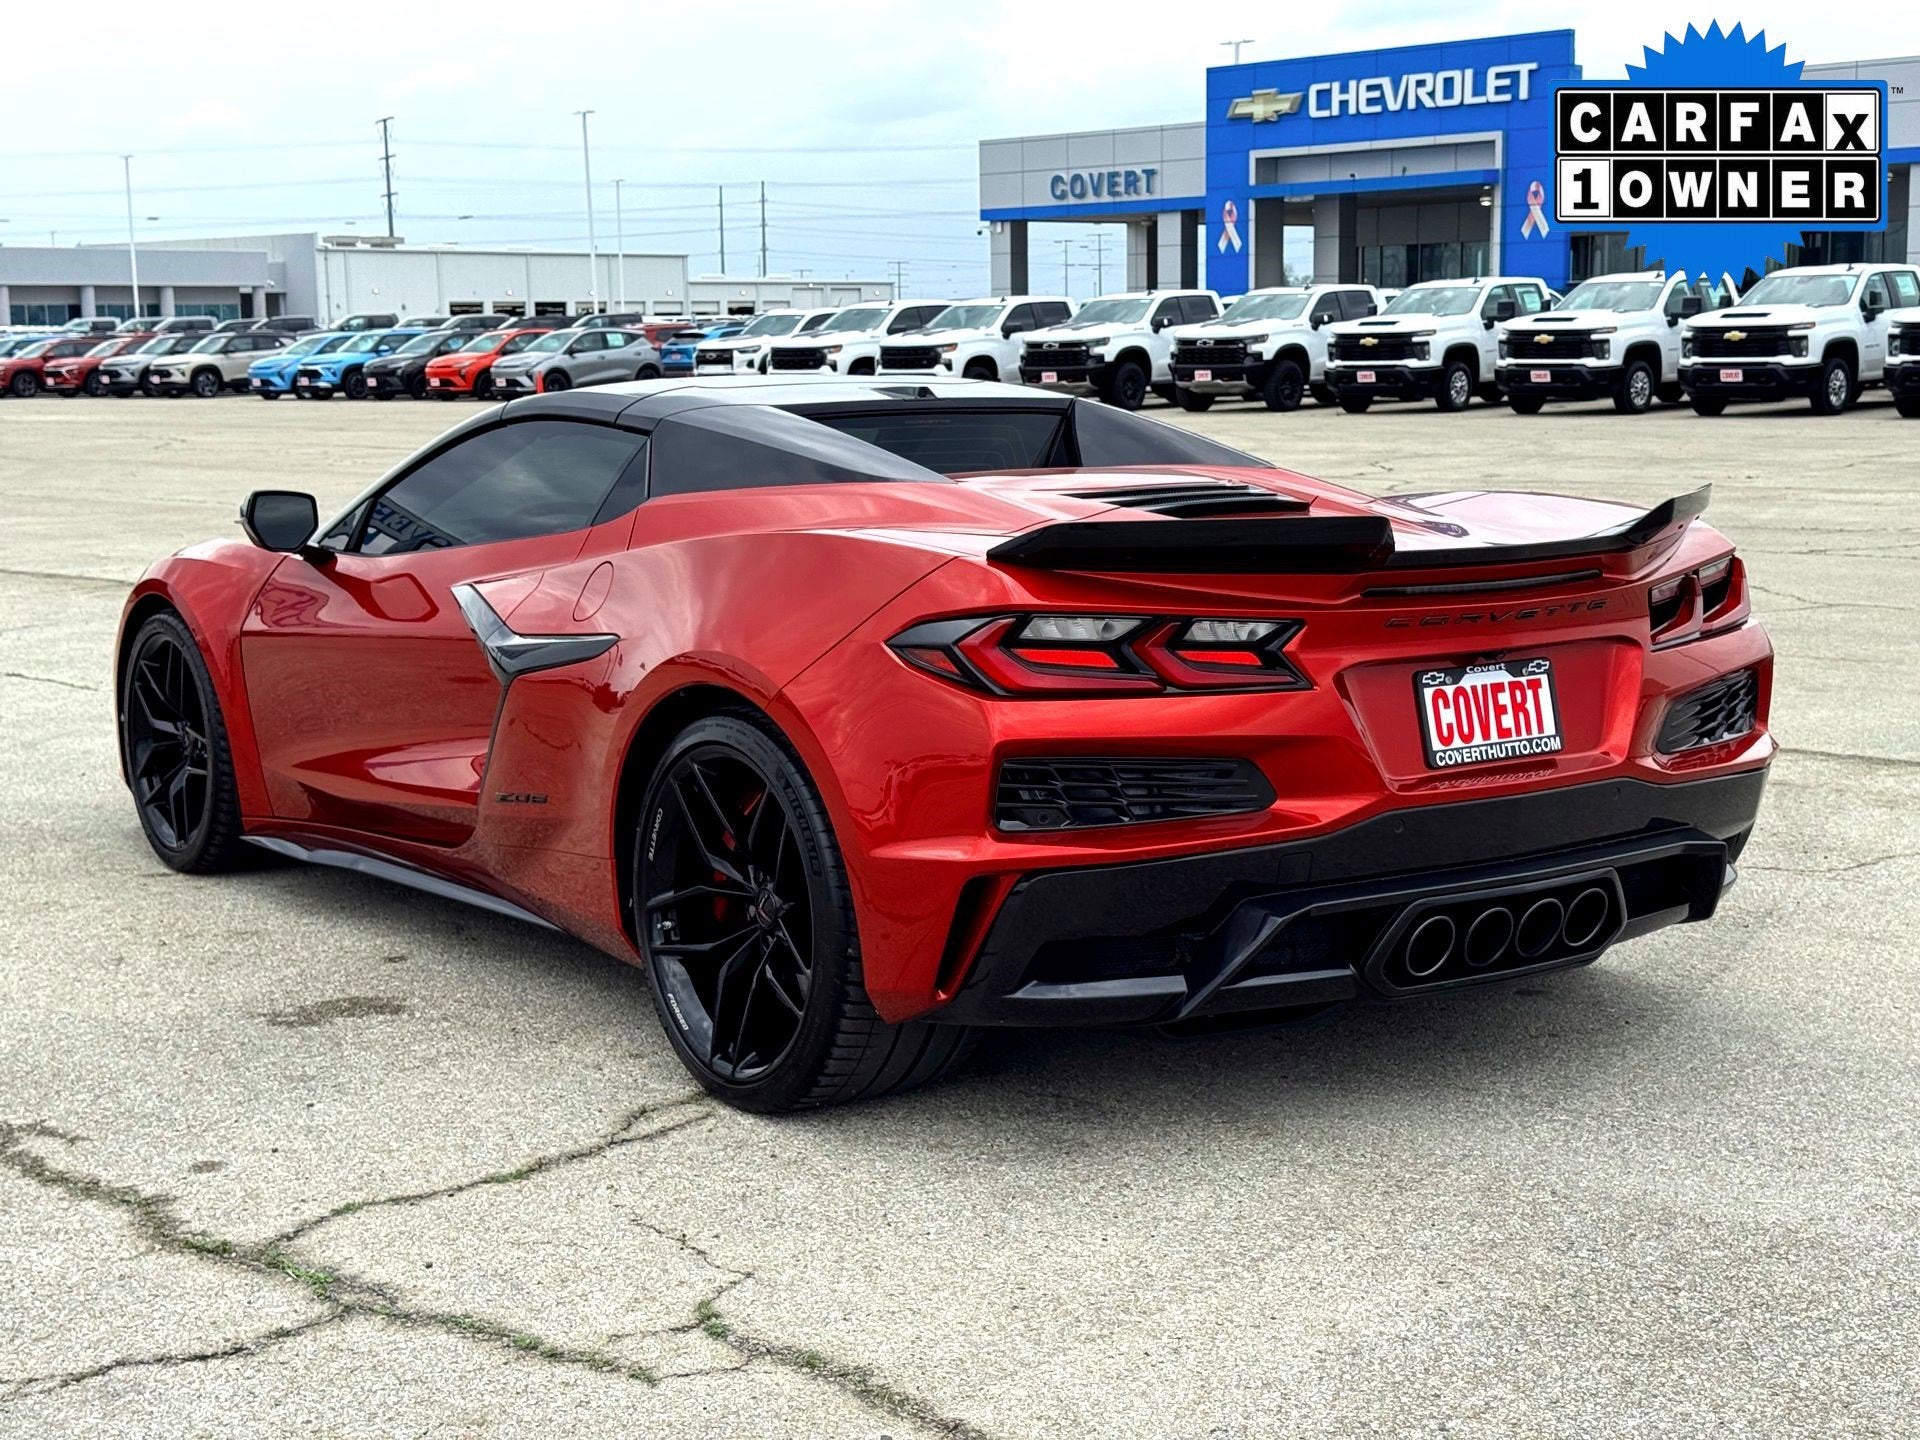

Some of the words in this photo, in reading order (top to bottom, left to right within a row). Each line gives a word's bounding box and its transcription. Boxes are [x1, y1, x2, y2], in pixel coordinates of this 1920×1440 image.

[1308, 62, 1538, 118] CHEVROLET
[1050, 168, 1157, 200] COVERT
[1384, 598, 1608, 628] CORVETTE
[1466, 663, 1505, 674] Covert
[1431, 678, 1545, 747] COVERT
[1436, 737, 1561, 767] COVERTHUTTO.COM
[667, 993, 689, 1030] FORGED
